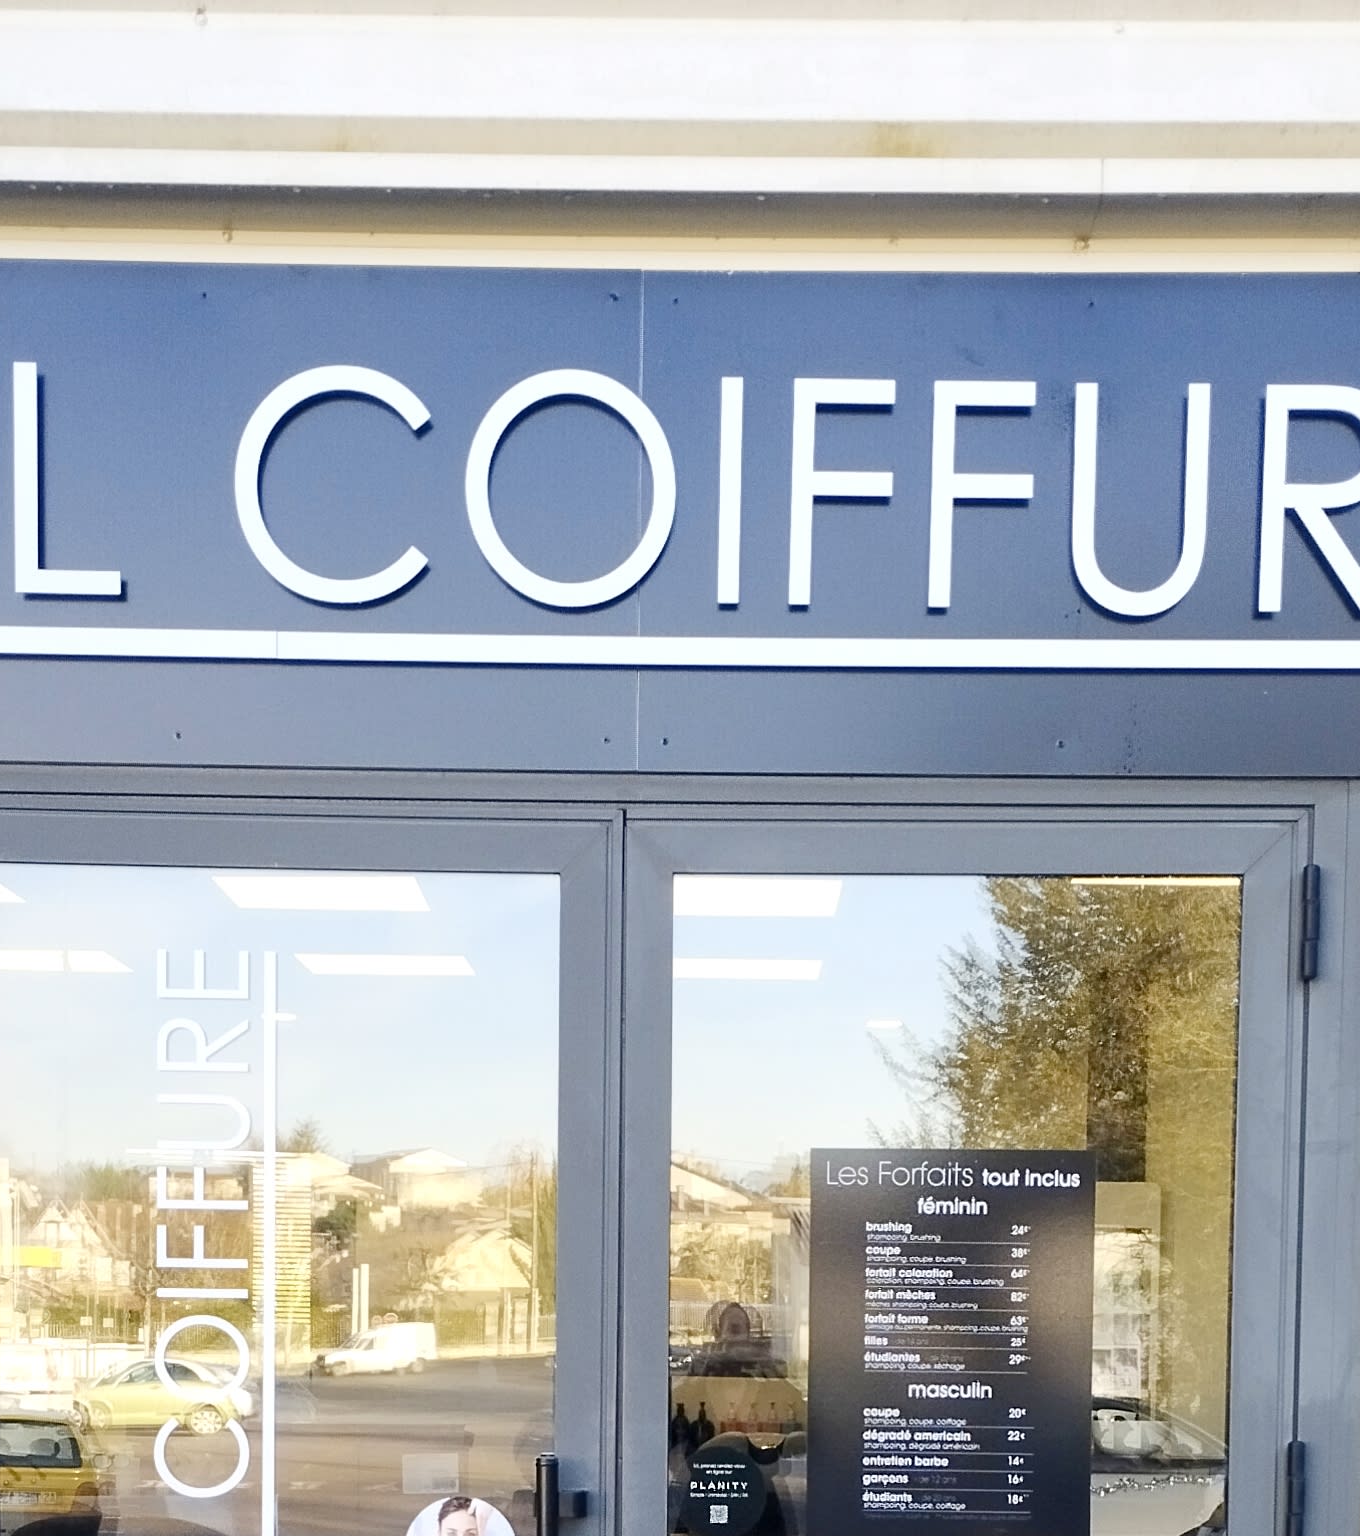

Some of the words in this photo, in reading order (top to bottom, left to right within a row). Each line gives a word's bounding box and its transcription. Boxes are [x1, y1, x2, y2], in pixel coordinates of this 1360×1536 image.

[826, 1160, 869, 1186] Les
[878, 1160, 975, 1187] Forfaits
[981, 1168, 1021, 1187] tout
[1025, 1168, 1081, 1188] inclus
[917, 1196, 989, 1216] féminin
[153, 948, 251, 1499] COIFFURE
[865, 1221, 913, 1234] brushing
[865, 1246, 901, 1257] coupe
[907, 1380, 993, 1400] masculin
[862, 1407, 901, 1419] coupe
[914, 1455, 950, 1467] barbe
[690, 1481, 749, 1490] PLANITY
